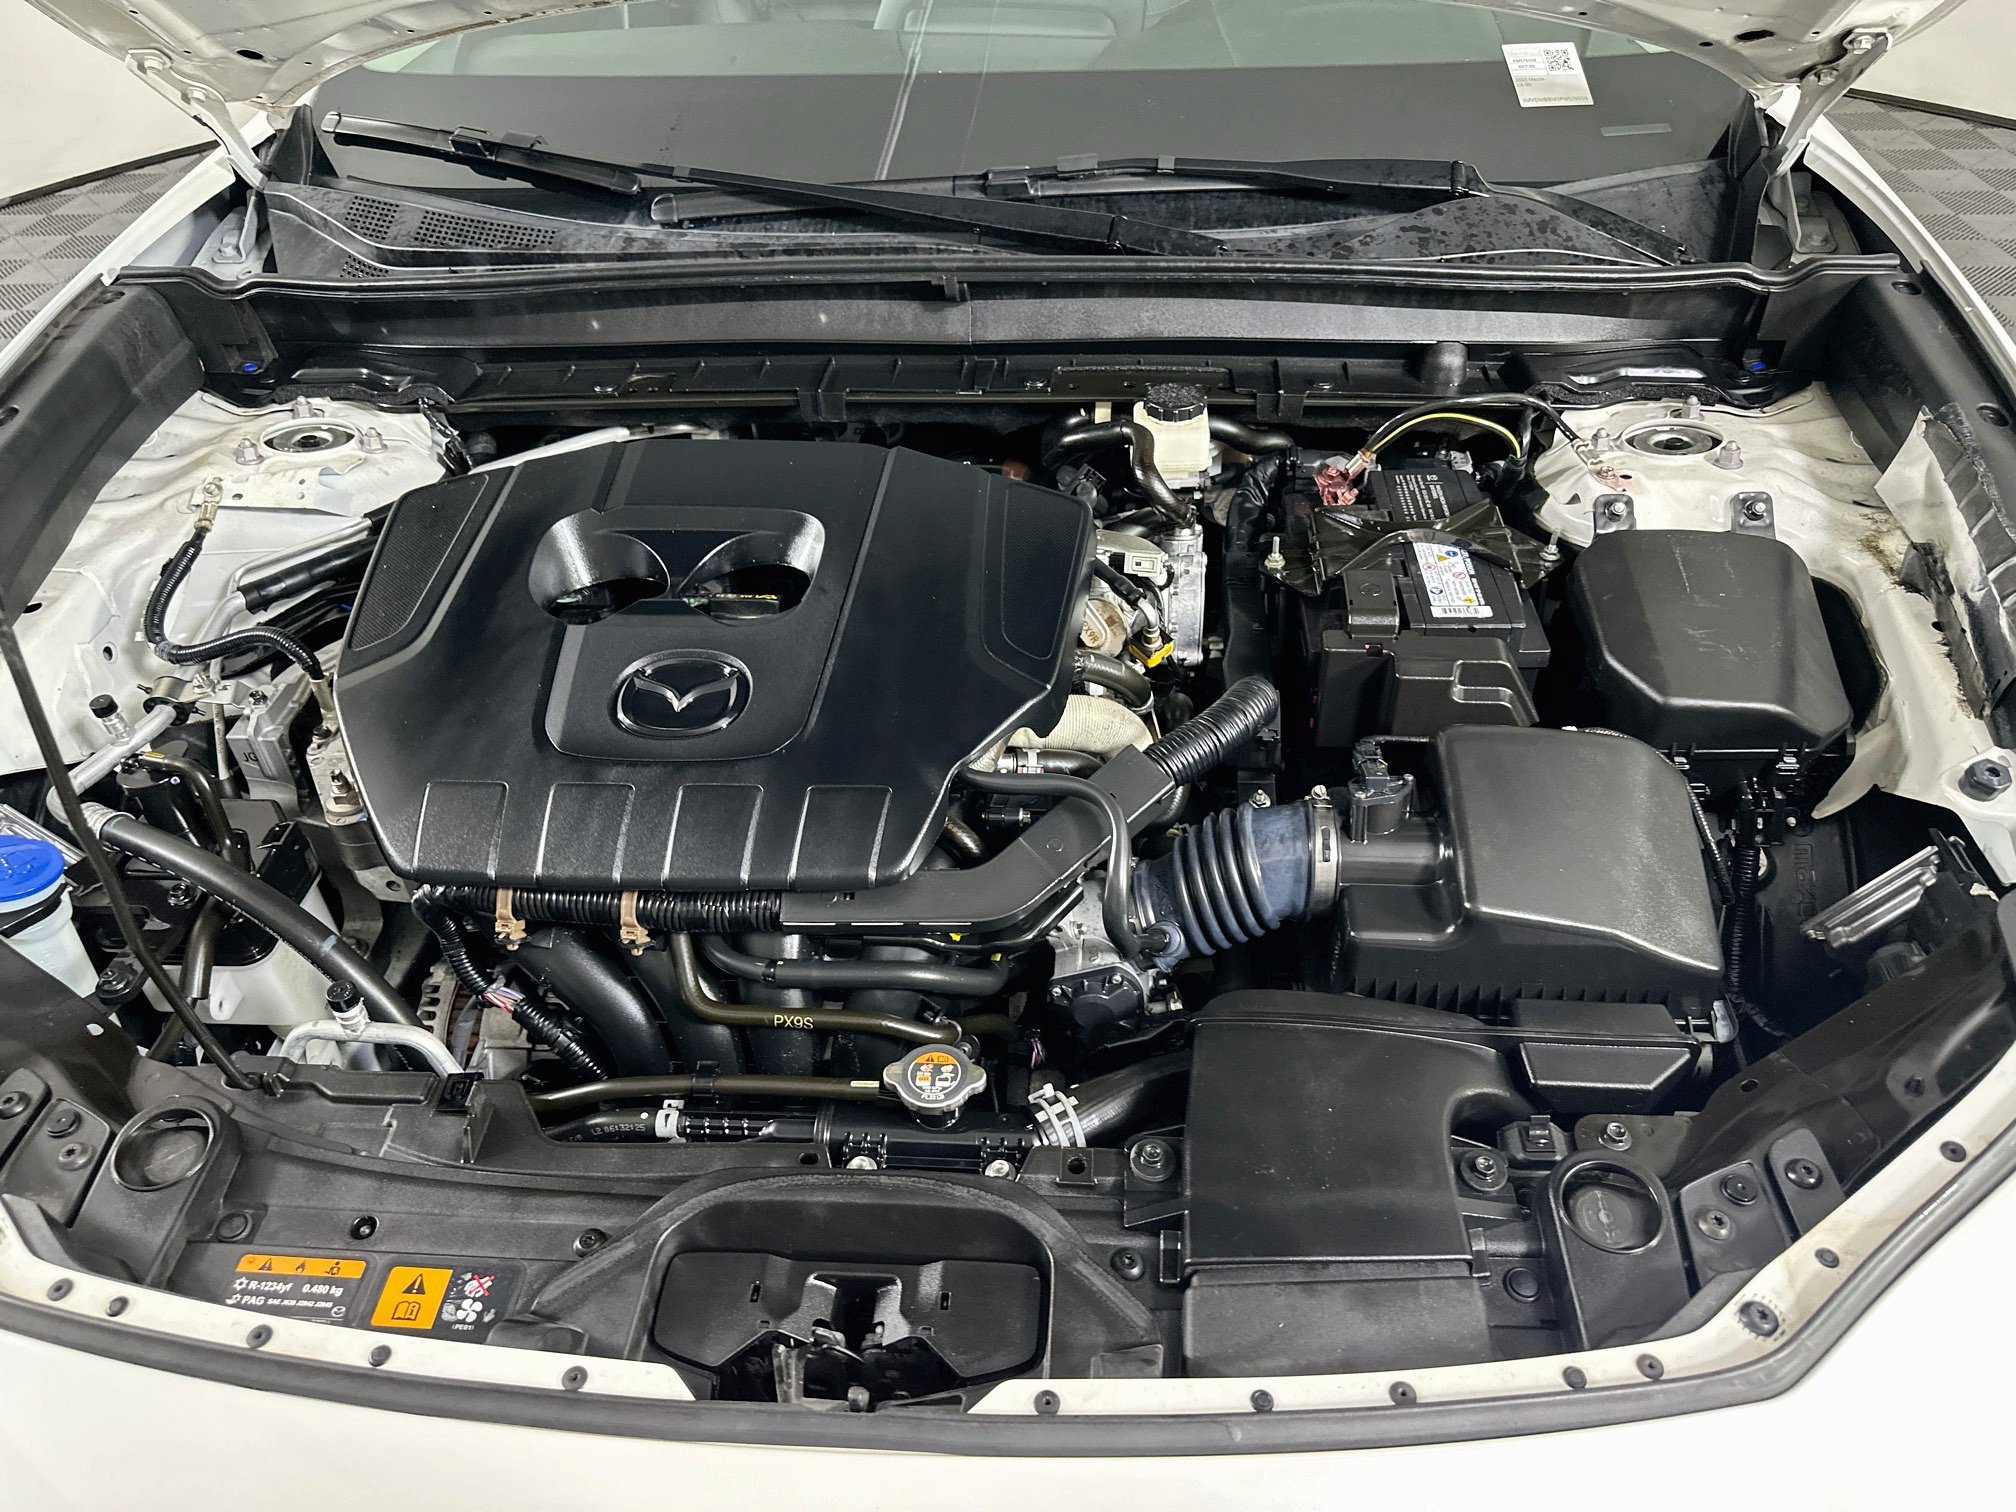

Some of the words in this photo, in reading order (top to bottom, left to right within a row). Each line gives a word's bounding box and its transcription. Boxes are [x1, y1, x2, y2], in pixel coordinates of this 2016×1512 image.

[773, 1014, 814, 1030] PX9S
[248, 1280, 293, 1293] R-1234yf
[302, 1283, 330, 1295] 0.480
[329, 1285, 344, 1297] kg
[241, 1295, 265, 1305] PAG
